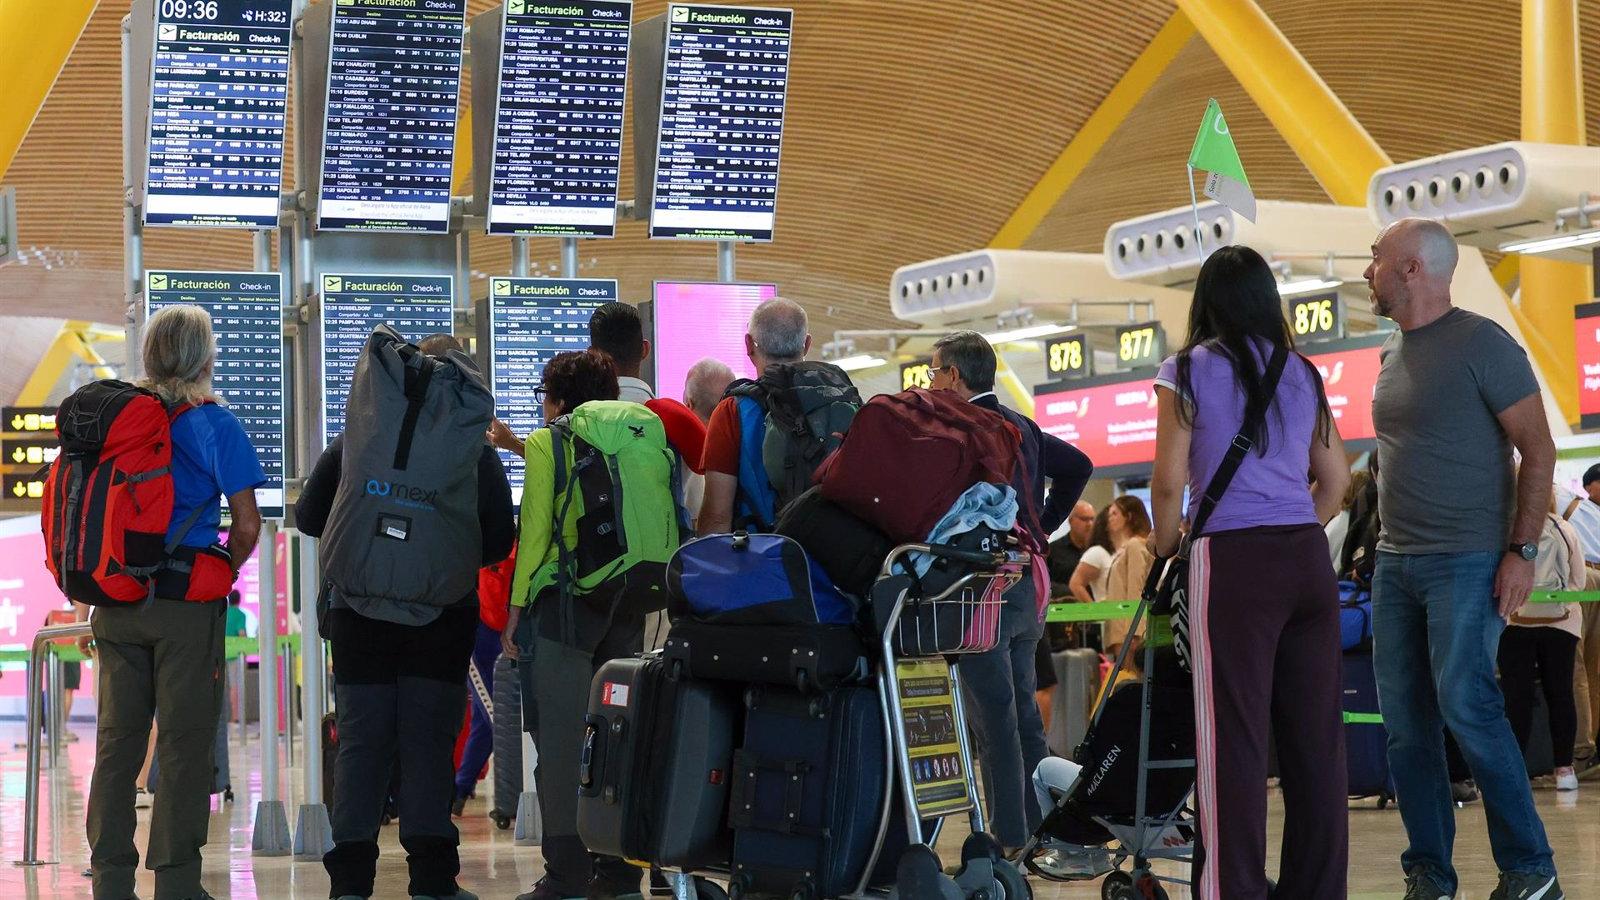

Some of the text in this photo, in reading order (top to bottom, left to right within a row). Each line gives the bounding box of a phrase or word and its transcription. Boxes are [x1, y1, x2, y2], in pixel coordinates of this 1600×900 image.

[162, 0, 218, 20] 09:36
[528, 5, 583, 15] Facturación
[691, 12, 782, 25] Facturación Check-in
[180, 30, 281, 43] Facturación Check-in
[171, 280, 230, 289] Facturación
[345, 281, 402, 291] Facturación
[514, 286, 569, 295] Facturación
[1295, 300, 1333, 334] 876
[1120, 328, 1153, 360] 877
[1050, 341, 1082, 372] 878
[903, 364, 931, 390] 879
[1087, 745, 1122, 797] MACLAREN
